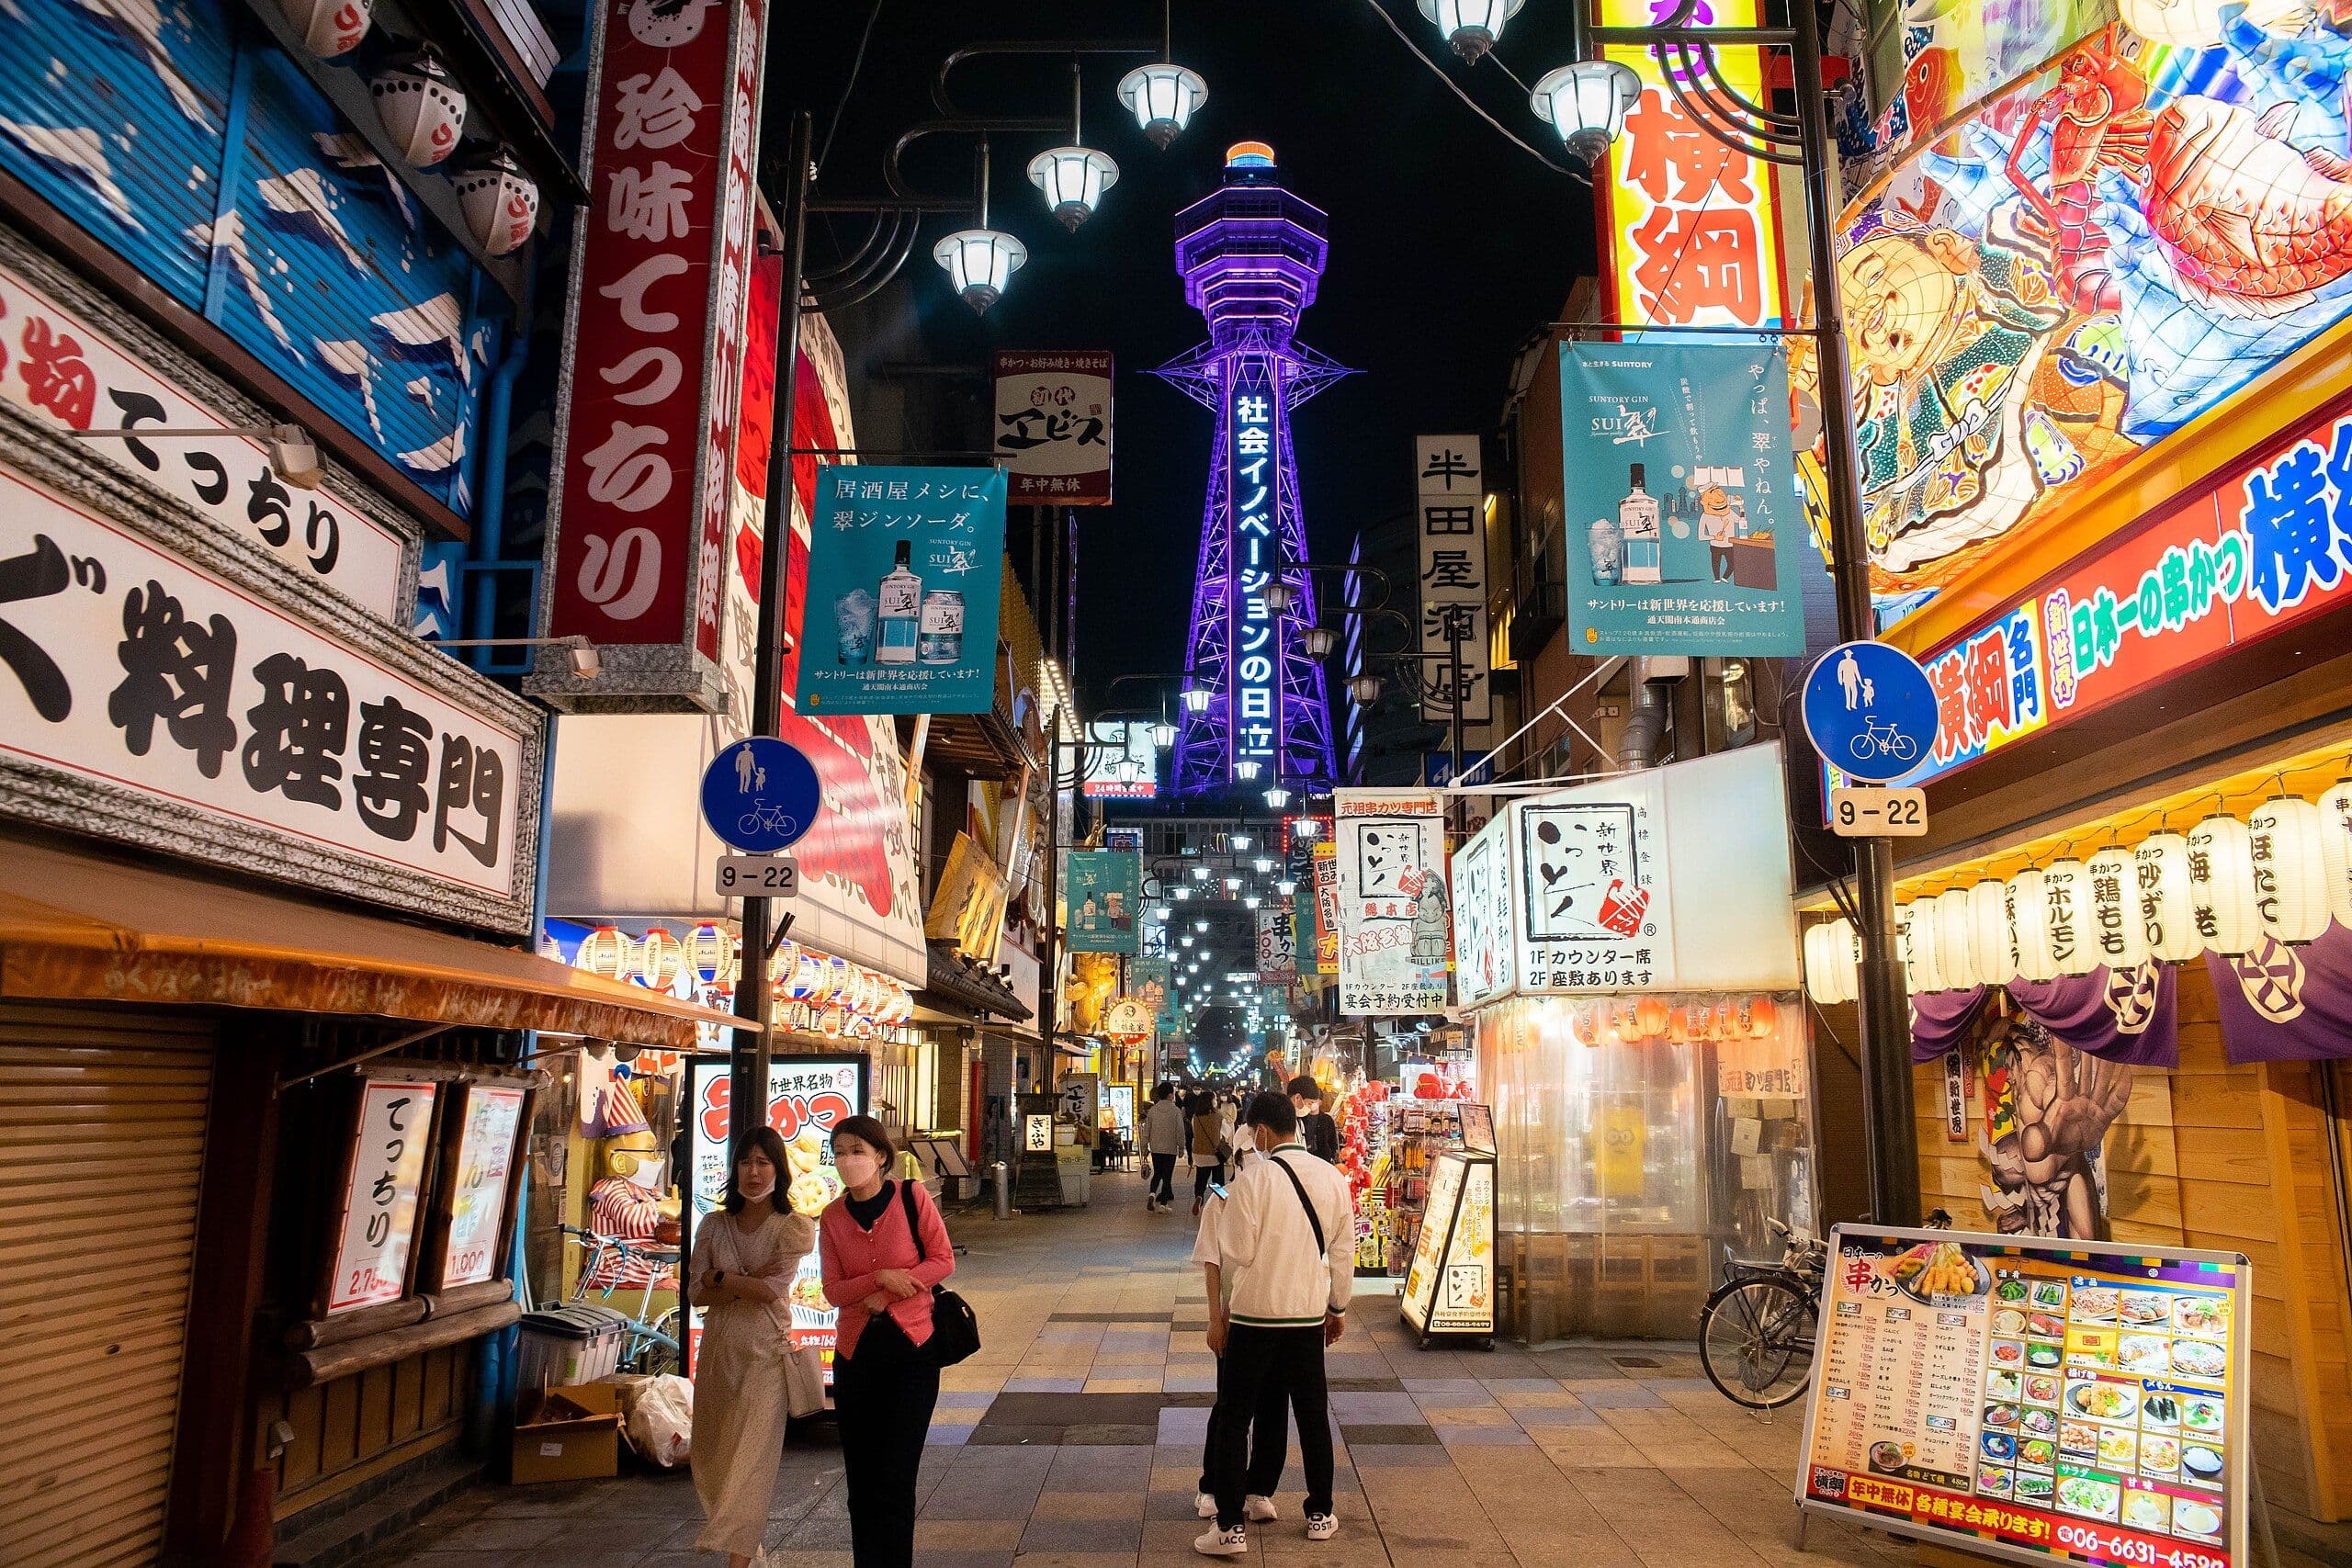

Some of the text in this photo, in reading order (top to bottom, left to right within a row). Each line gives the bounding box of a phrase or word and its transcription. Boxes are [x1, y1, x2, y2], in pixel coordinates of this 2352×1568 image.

[1625, 88, 1761, 326] 横綱
[576, 65, 703, 621] 珍味てっちり
[1589, 396, 1628, 404] SUNTORY
[997, 408, 1106, 449] エビス
[1591, 418, 1622, 432] SUI
[107, 386, 340, 575] てっちり
[835, 480, 989, 502] 居酒屋メシに、
[1020, 478, 1080, 492] 年中無休
[832, 511, 974, 533] 翠ジンソーダ。
[929, 554, 951, 564] SUI
[1238, 396, 1273, 756] 社会イノベーションの日立
[1587, 599, 1785, 613] サントリーは新世界を応援しています!
[2072, 536, 2244, 672] 日本一の串かつ
[2048, 593, 2074, 704] 新世界
[814, 669, 979, 681] サントリーは新世界を応援しています!
[2008, 619, 2038, 724] 名門
[1341, 802, 1438, 815] 元祖串カツ専門店
[1637, 807, 1653, 886] 商標登録
[2189, 852, 2218, 938] 海老
[2251, 835, 2278, 924] ほたて
[1320, 887, 1335, 929] 大阪名物
[1365, 902, 1418, 917] 総本店
[2044, 874, 2075, 962] 串かつ ホルモン
[2090, 862, 2125, 954] 串かつ 鶏もも
[2138, 863, 2164, 946] 砂ずり
[1272, 912, 1295, 964] 串かつ
[1344, 924, 1413, 957] 大阪名物
[1530, 948, 1652, 964] 1F カウンター席
[1530, 970, 1653, 987] 2F 座敷あります
[1345, 993, 1443, 1009] 宴会予約受付中
[1032, 1117, 1045, 1148] ぎふや
[368, 1097, 411, 1248] てっちり
[1843, 1247, 1883, 1260] 日本一の
[1845, 1258, 1899, 1297] 串かつ
[2062, 1465, 2090, 1477] サラダ
[2128, 1477, 2154, 1492] 甘味
[1851, 1479, 1910, 1507] 年中無休
[1917, 1494, 2051, 1539] 各種宴会承ります!
